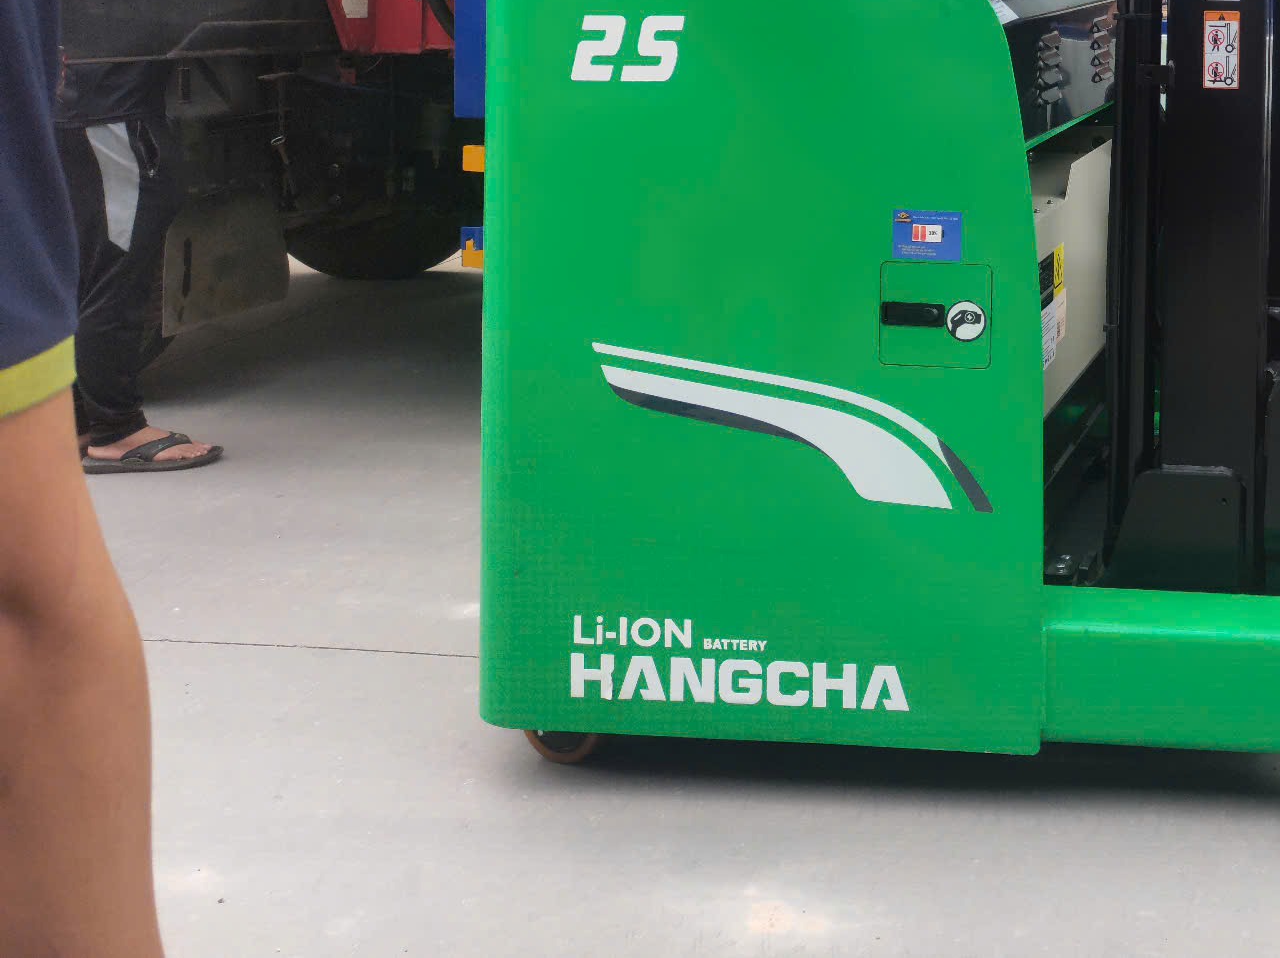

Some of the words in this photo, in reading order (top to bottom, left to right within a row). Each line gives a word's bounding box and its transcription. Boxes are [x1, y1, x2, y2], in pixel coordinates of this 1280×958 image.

[571, 15, 686, 82] 25
[573, 614, 692, 648] Li-ION
[703, 638, 768, 652] BATTERY
[570, 652, 910, 712] HANGCHA
